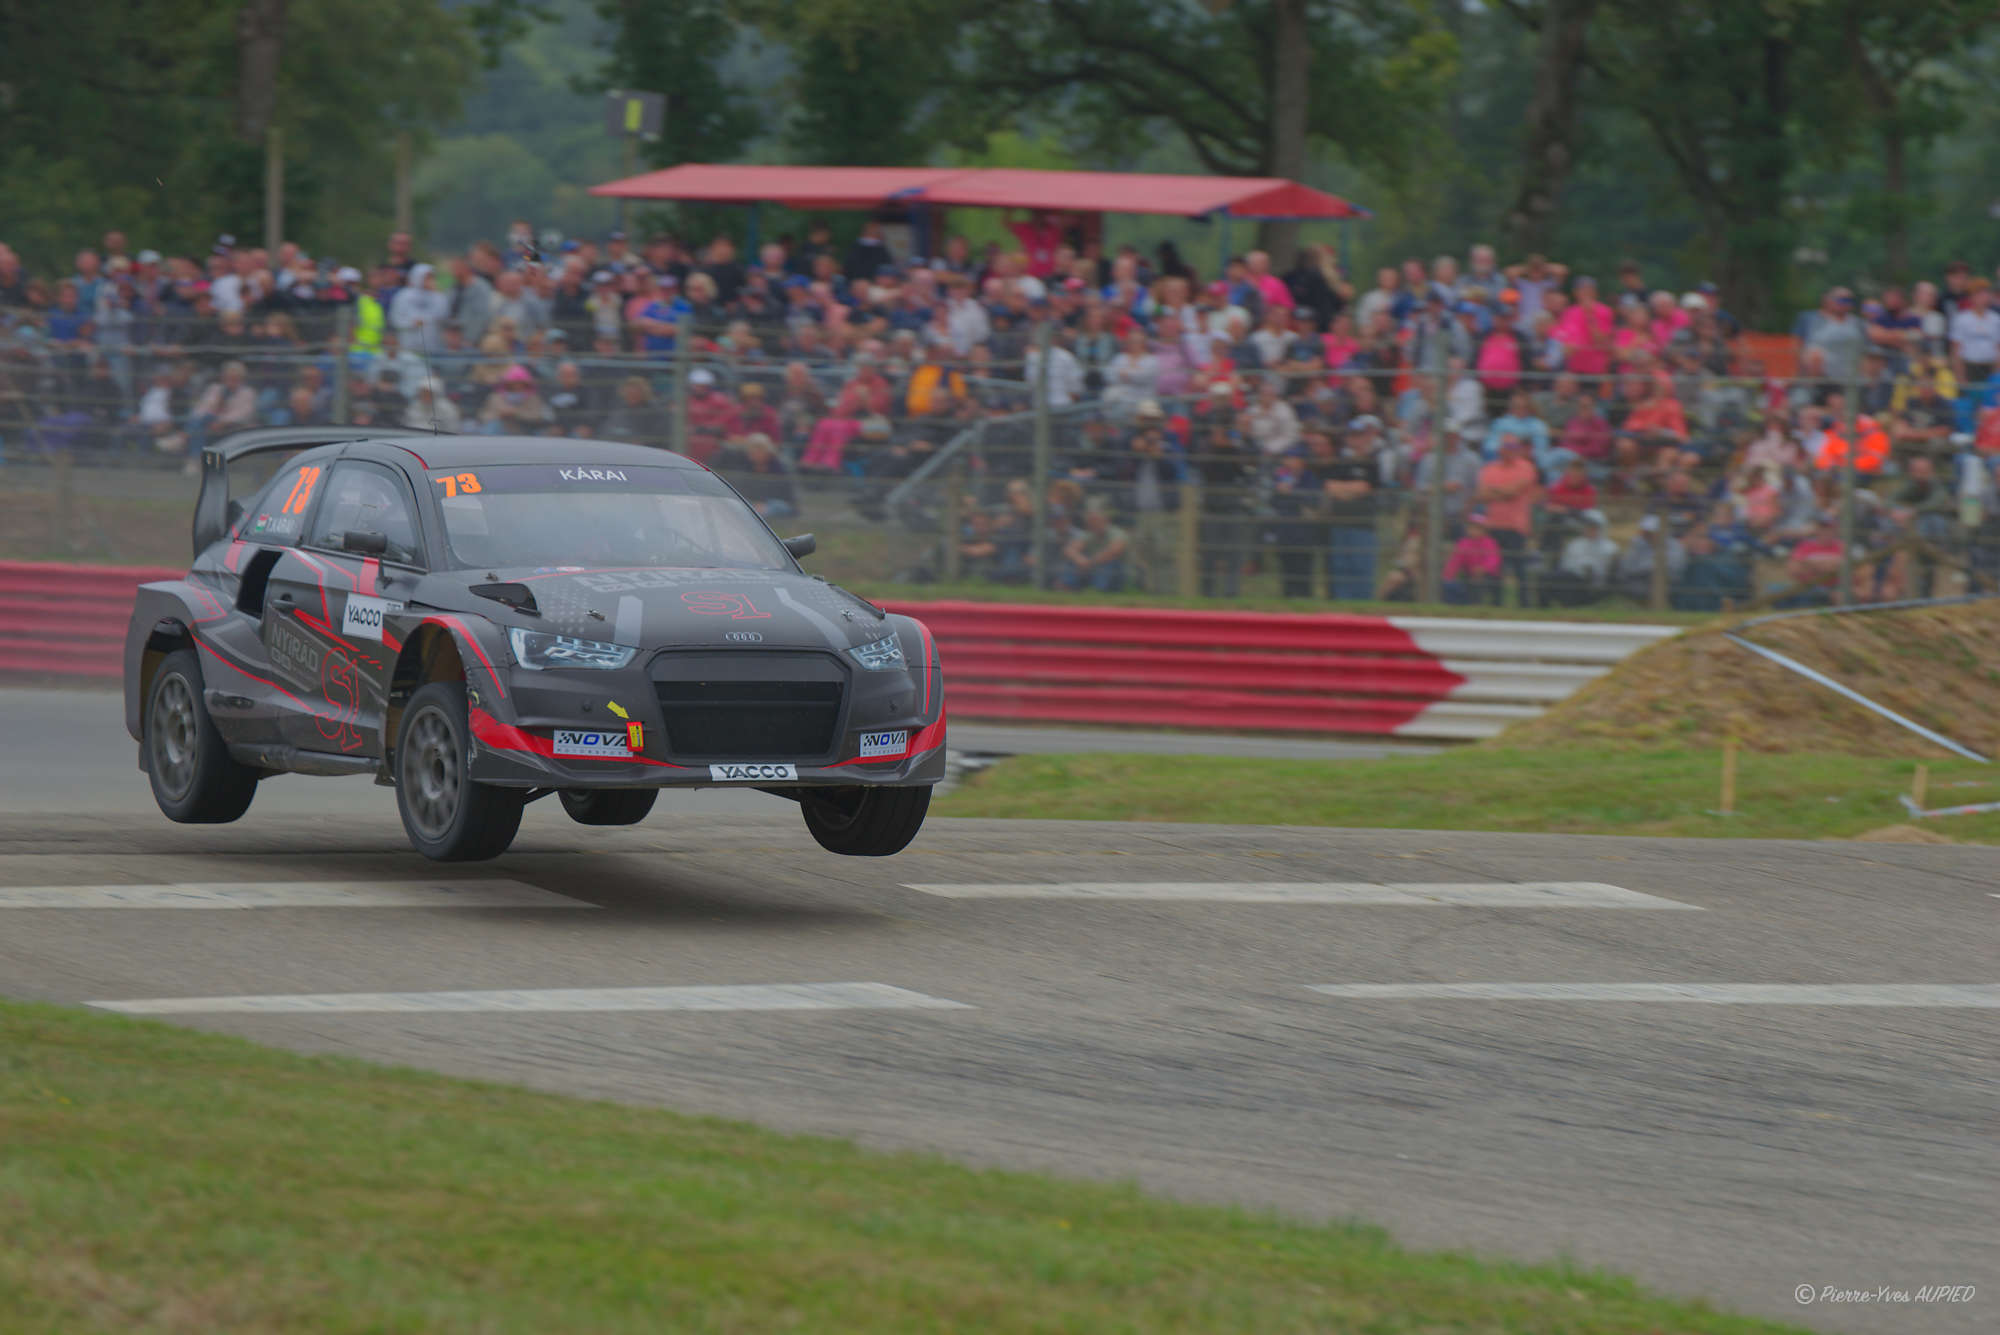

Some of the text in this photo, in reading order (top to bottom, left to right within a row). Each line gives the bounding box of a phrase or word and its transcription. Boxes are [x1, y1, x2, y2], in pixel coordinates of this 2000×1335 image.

[559, 466, 628, 481] KÁRAI
[282, 466, 321, 514] 73
[435, 472, 482, 498] 73
[349, 604, 381, 627] YACCO
[565, 732, 627, 747] NOVA
[870, 732, 905, 746] NOVA
[718, 765, 789, 779] YACCO
